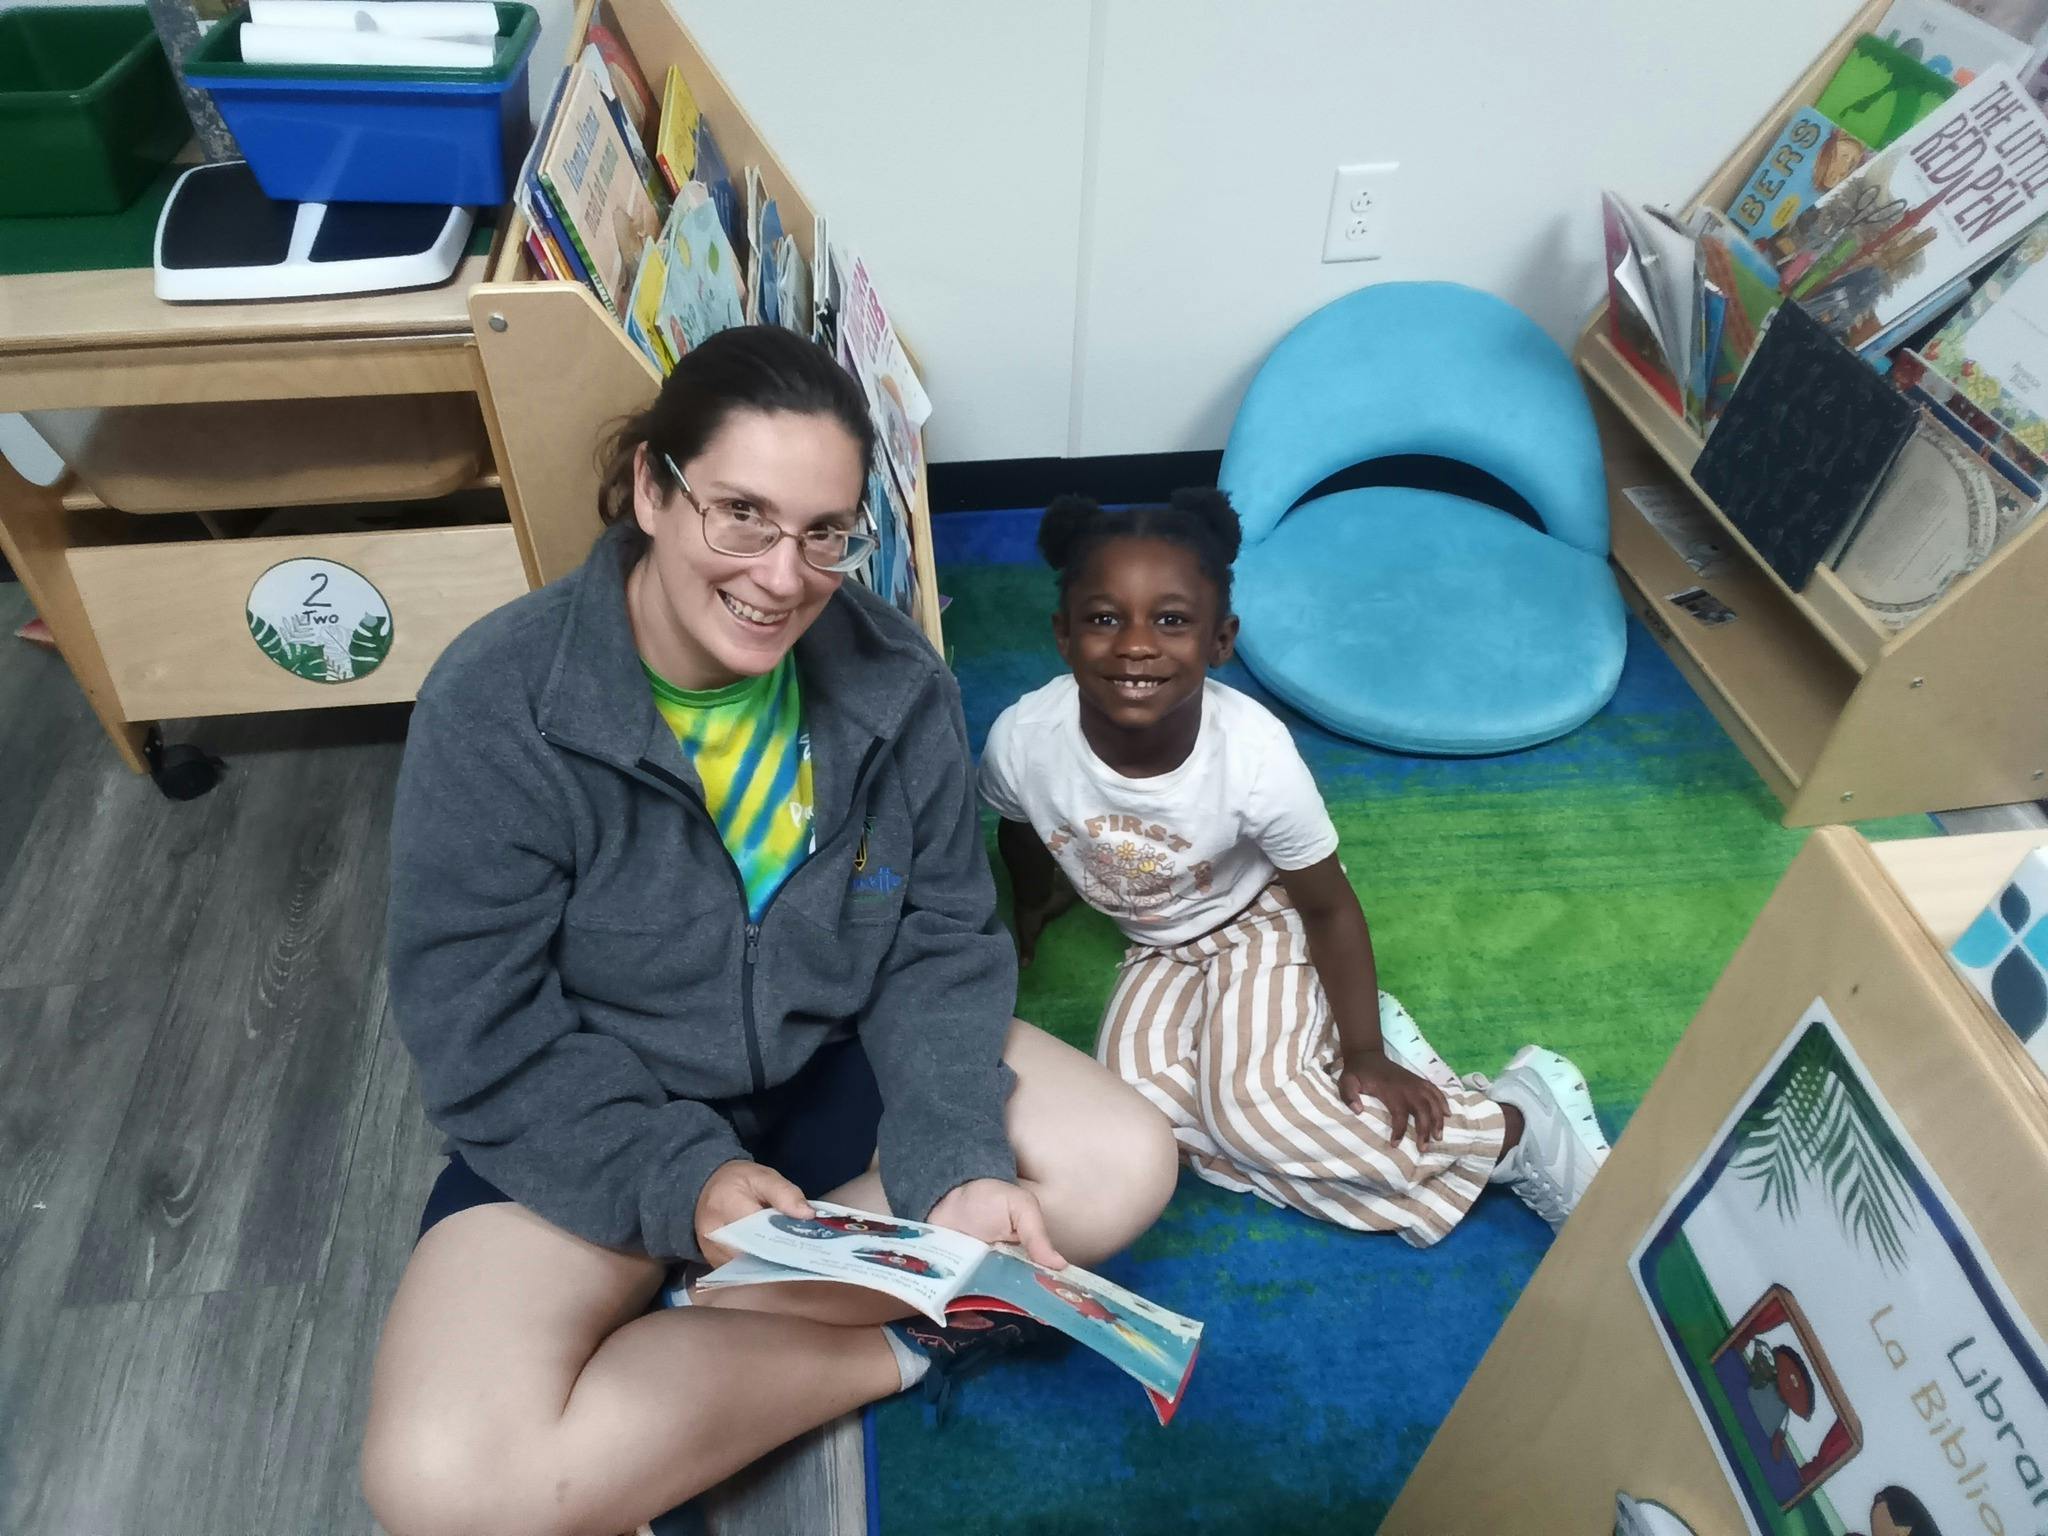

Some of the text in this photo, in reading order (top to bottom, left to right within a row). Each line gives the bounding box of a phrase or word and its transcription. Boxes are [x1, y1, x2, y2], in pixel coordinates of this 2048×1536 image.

[1969, 81, 2028, 137] THE
[1729, 118, 1821, 235] BERS
[1910, 112, 2026, 242] RED PEN
[303, 573, 332, 607] 2
[1084, 814, 1193, 853] FIRST
[1869, 1304, 2005, 1536] La Biblio
[1947, 1336, 2048, 1508] Librar
